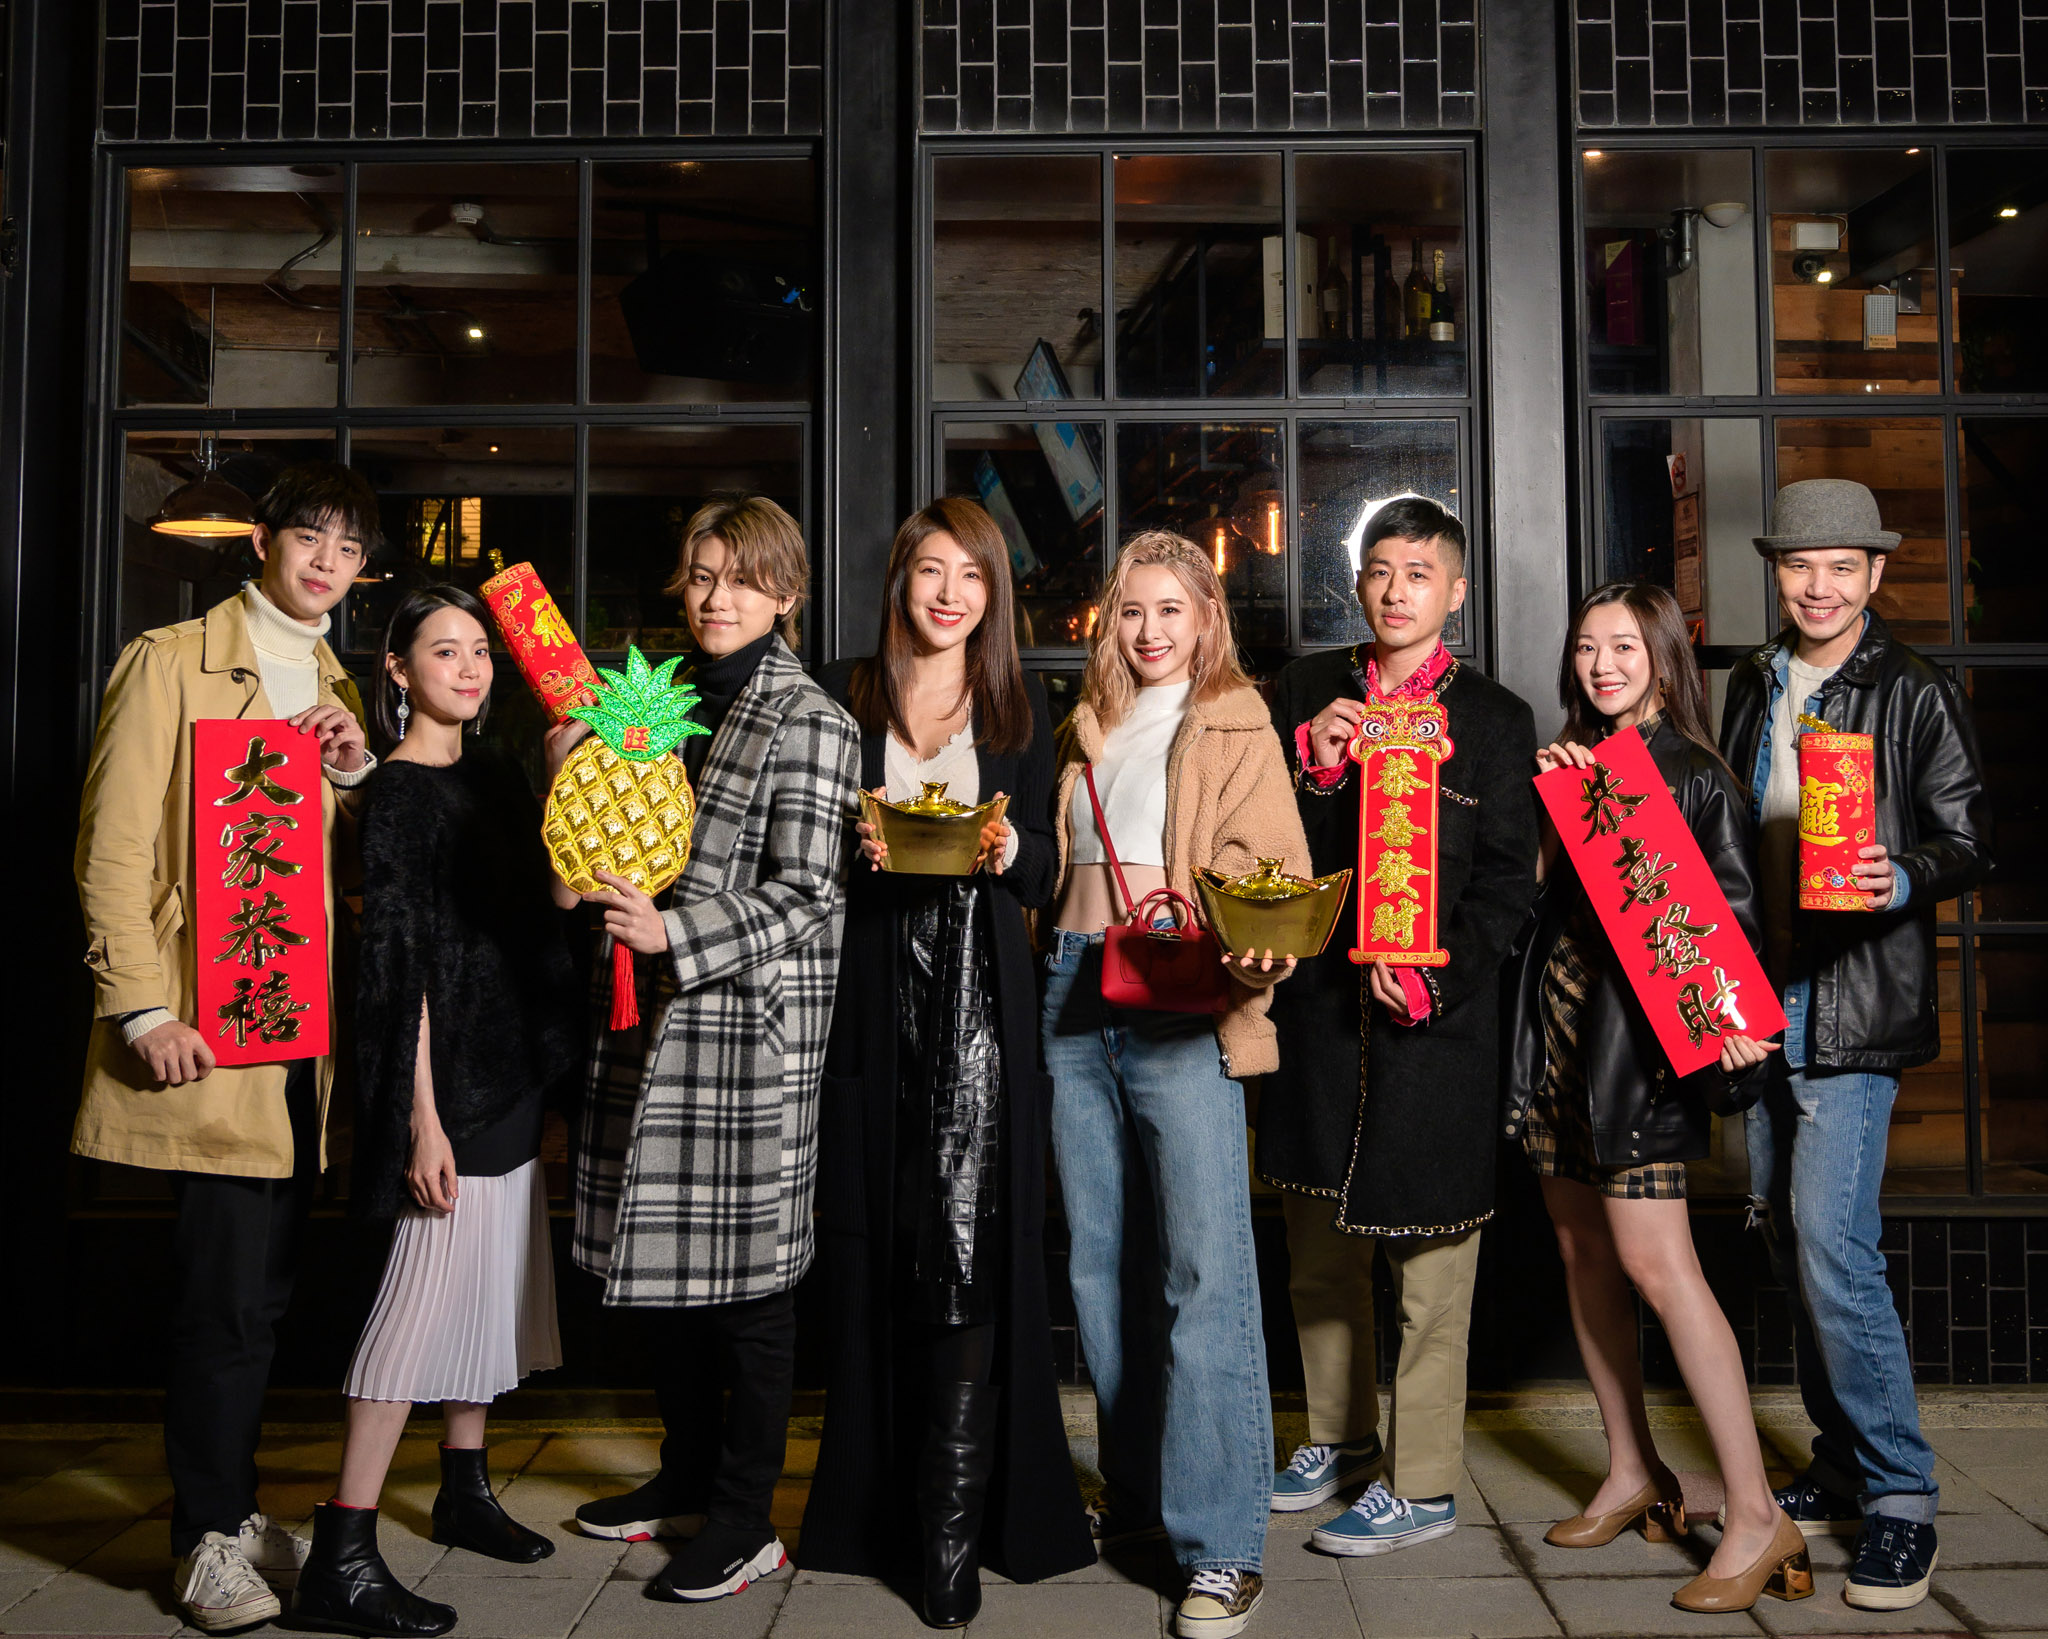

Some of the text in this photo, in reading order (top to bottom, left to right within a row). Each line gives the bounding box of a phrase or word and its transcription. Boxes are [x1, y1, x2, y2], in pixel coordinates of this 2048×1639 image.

[623, 726, 650, 752] 旺
[1367, 751, 1430, 949] 恭喜發財
[1581, 762, 1748, 1049] 恭喜發財
